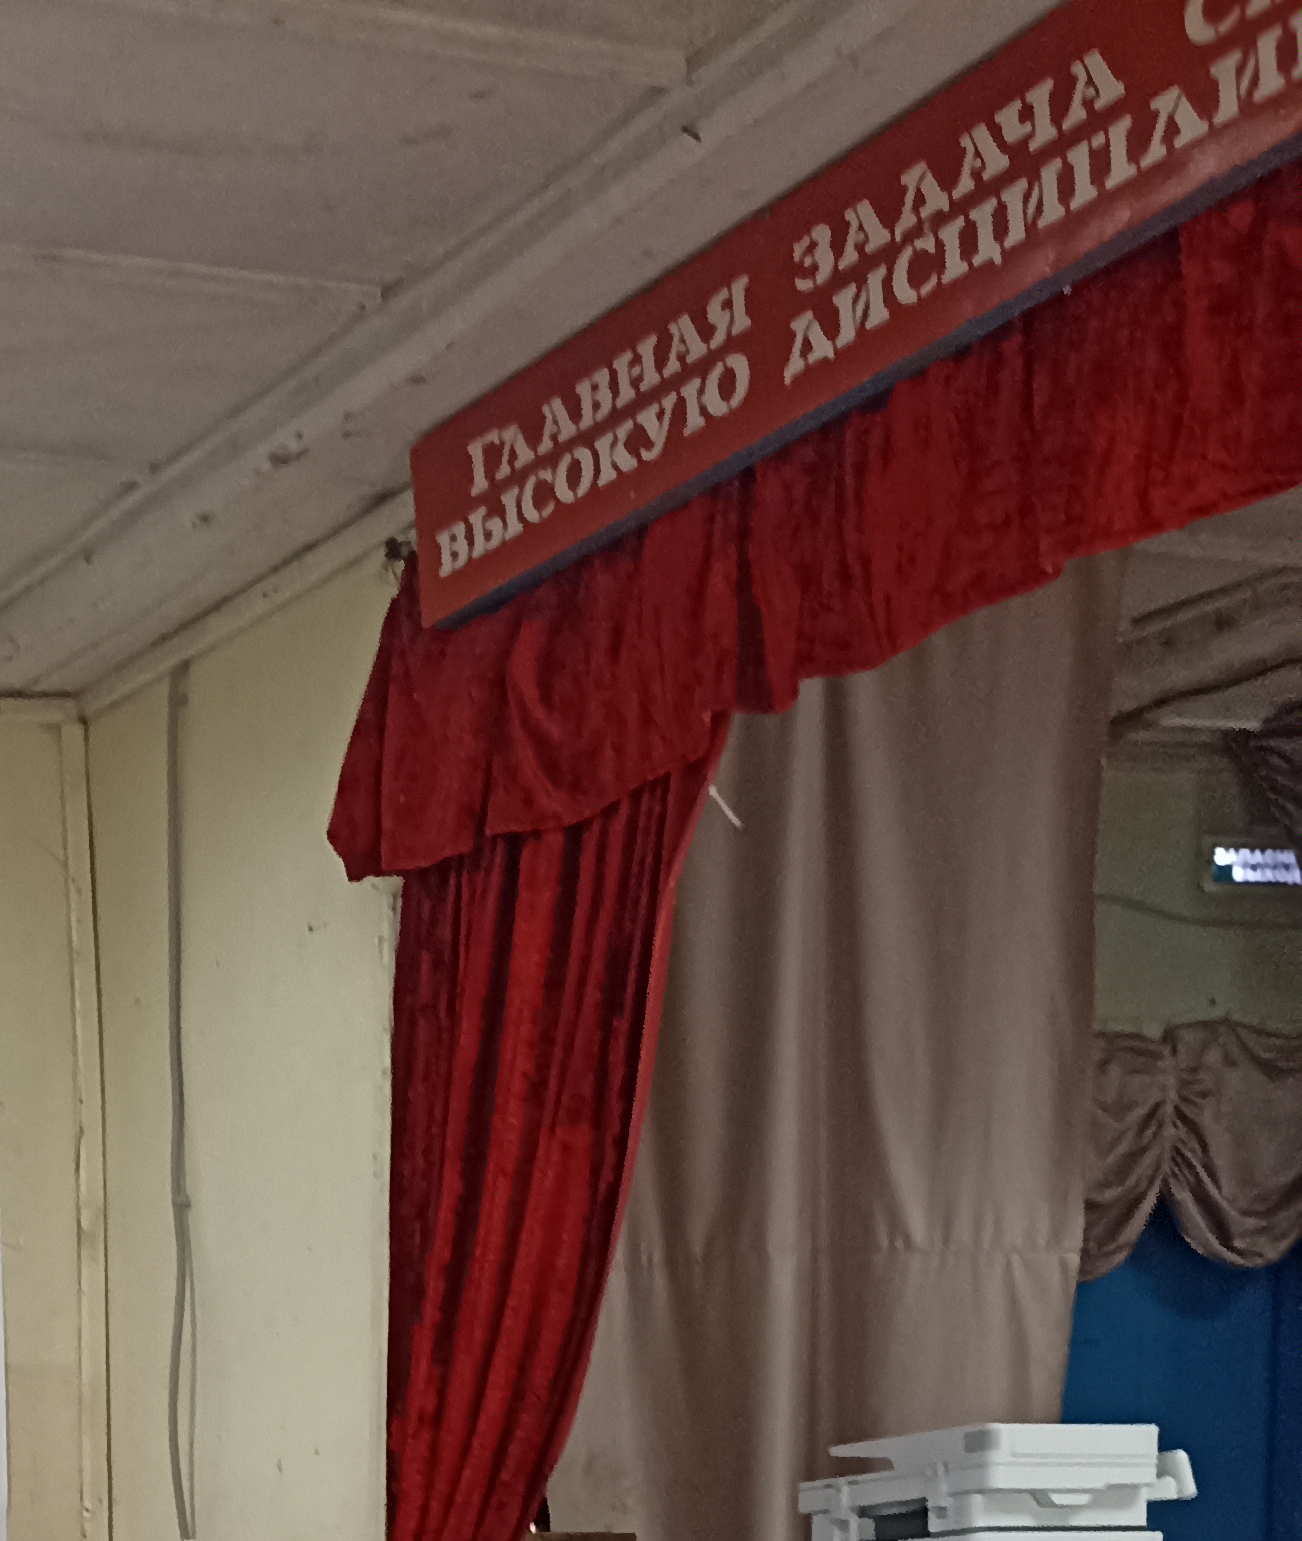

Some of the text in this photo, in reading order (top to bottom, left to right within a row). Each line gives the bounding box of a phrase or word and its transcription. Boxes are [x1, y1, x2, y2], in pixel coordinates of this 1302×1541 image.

[435, 9, 1302, 578] ВЫСОКУЮ ДИСЦИПЛИ
[467, 274, 752, 497] ГЛАВНАЯ
[793, 48, 1126, 292] ЗАДАЧА
